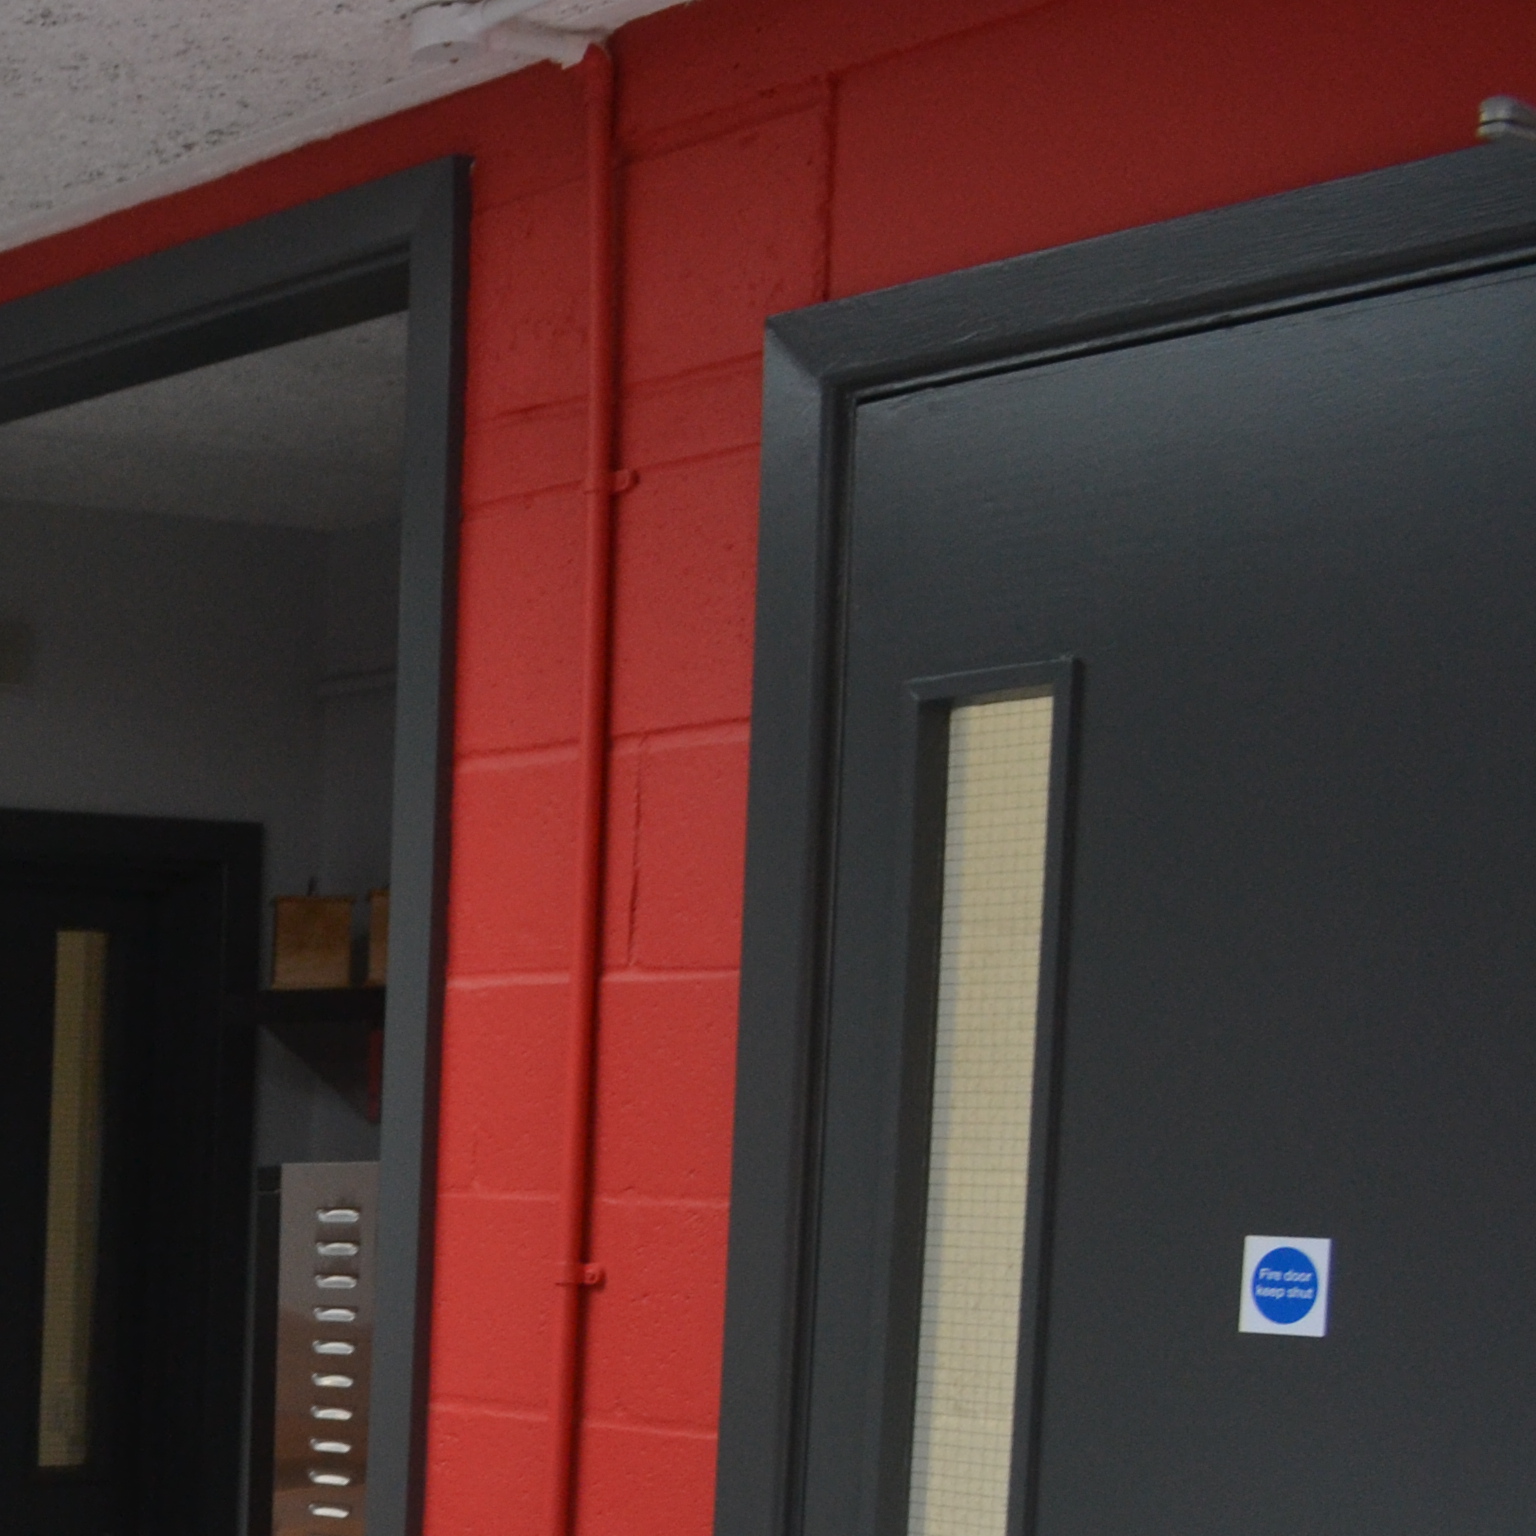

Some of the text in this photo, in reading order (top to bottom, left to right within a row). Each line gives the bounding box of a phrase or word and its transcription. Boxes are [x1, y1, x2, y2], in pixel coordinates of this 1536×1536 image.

[1259, 1267, 1313, 1282] Fire door
[1255, 1284, 1314, 1299] keep shut
